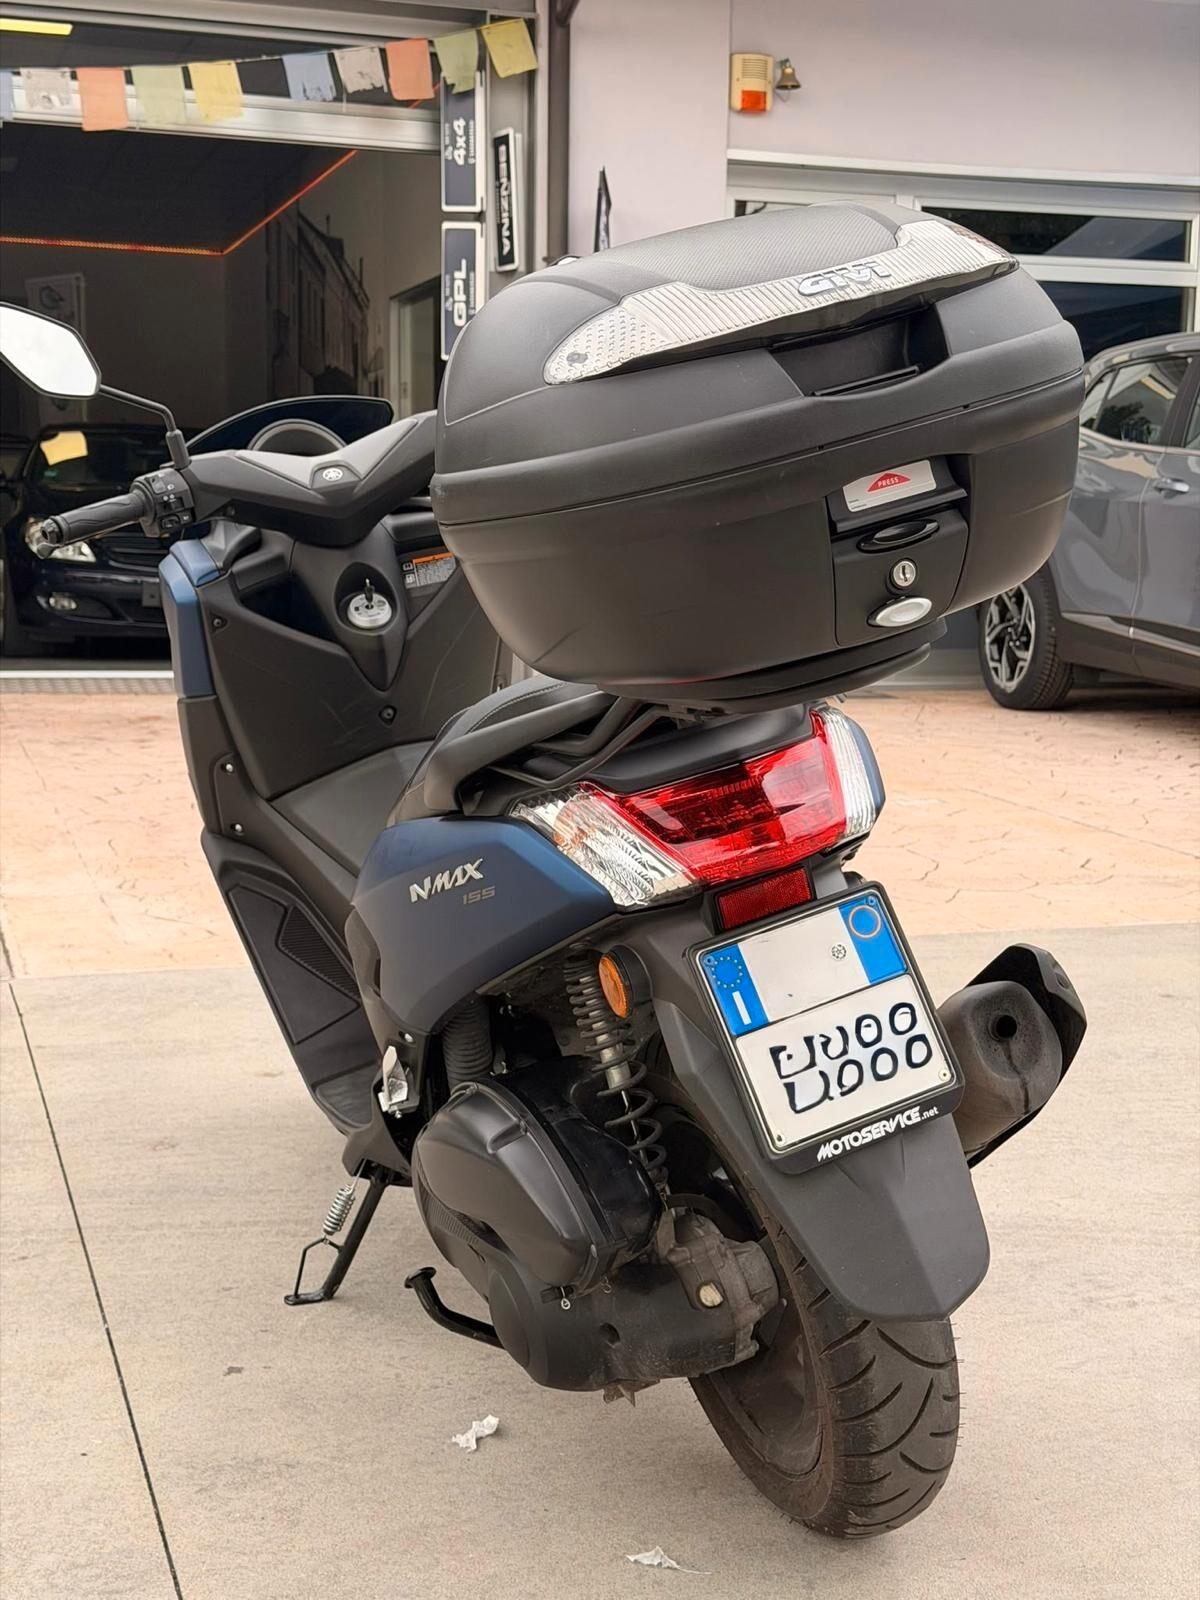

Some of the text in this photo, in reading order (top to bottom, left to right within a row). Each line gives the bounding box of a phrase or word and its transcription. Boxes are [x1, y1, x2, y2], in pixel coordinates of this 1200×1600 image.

[453, 117, 466, 165] 4x4
[498, 144, 511, 256] BENZINA
[454, 258, 467, 327] GPL
[877, 476, 900, 488] PRESS
[409, 858, 484, 903] NMAX
[462, 885, 496, 905] 155
